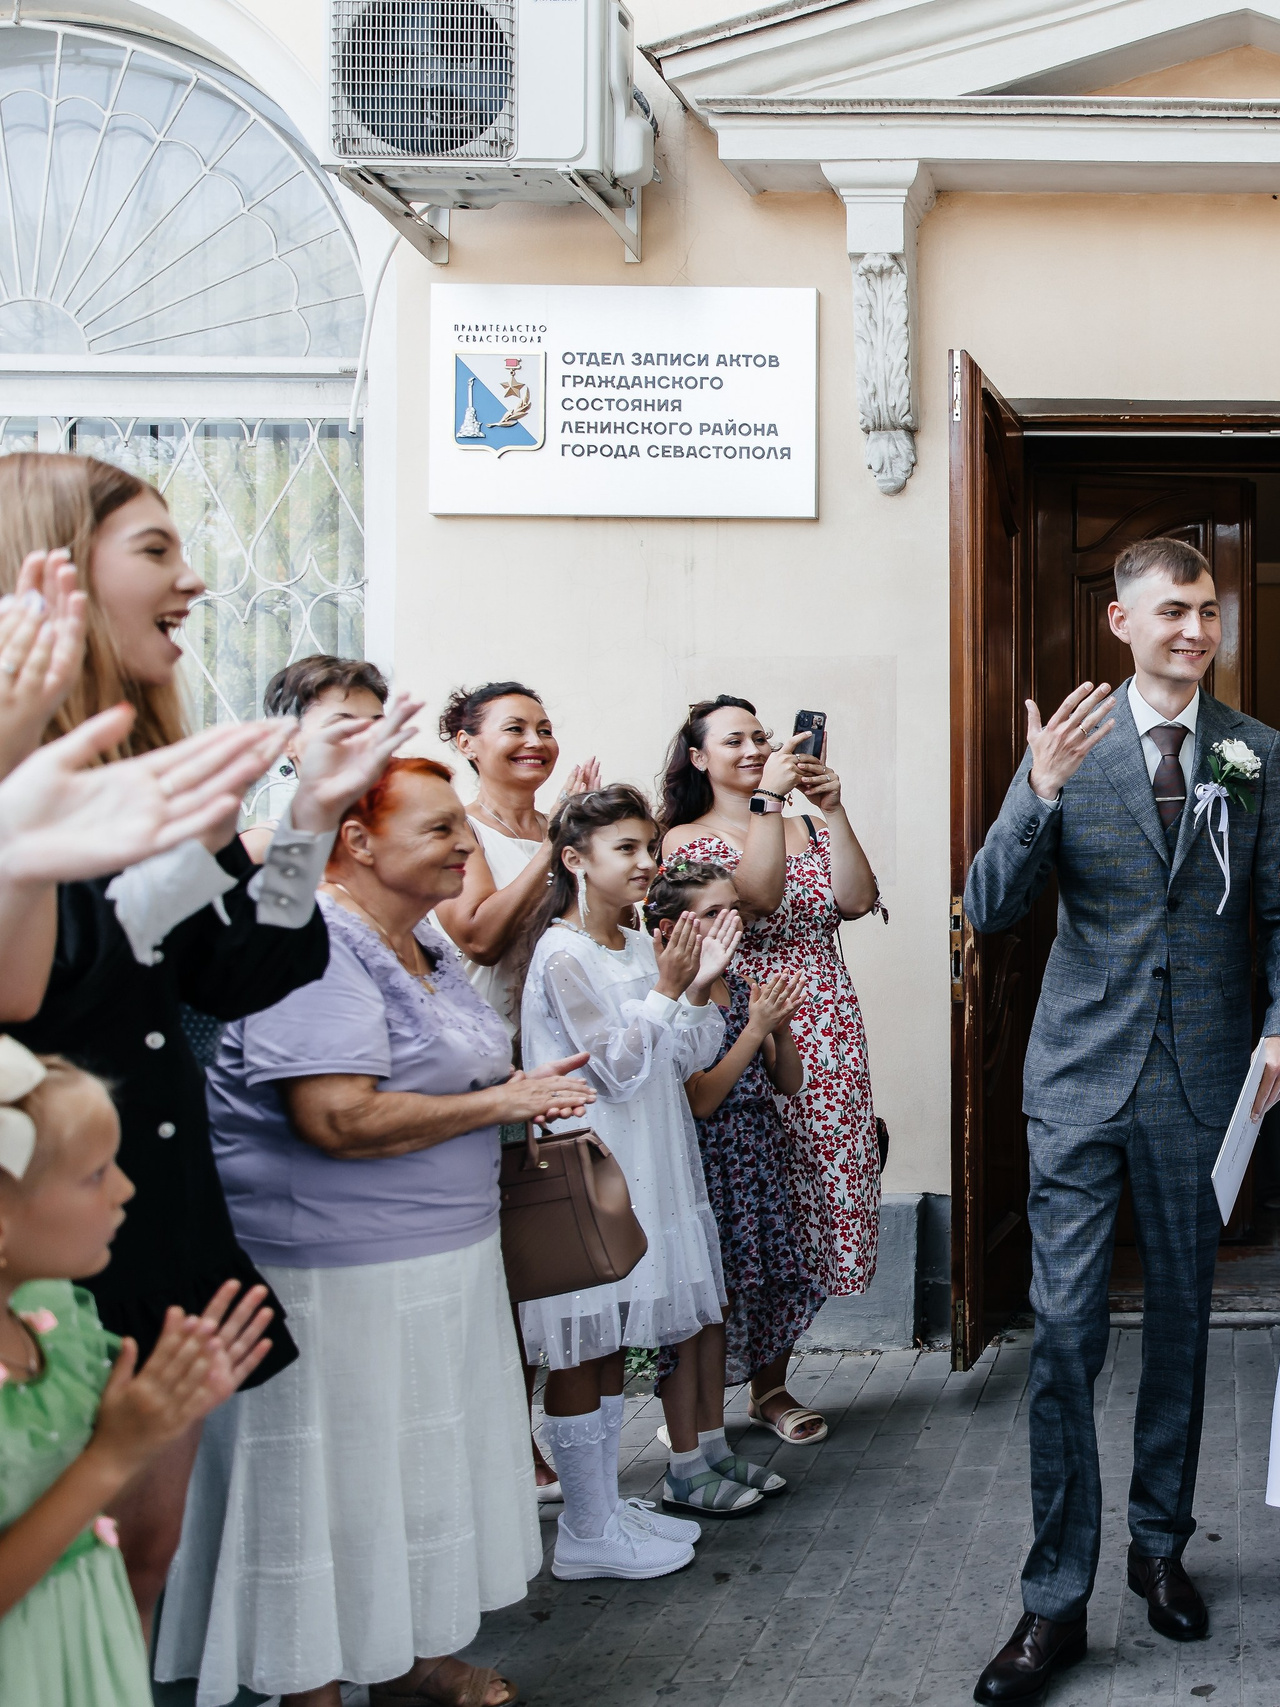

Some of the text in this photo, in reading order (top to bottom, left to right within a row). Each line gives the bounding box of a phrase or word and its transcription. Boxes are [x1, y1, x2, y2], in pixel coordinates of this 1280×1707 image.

[453, 324, 548, 333] ПРАВИТЕЛЬСТВО
[457, 334, 542, 344] СЕВАСТОПОЛЯ
[561, 351, 780, 369] ОТДЕЛ ЗАПИСИ АКТОВ
[561, 374, 724, 391] ГРАЖДАНСКОГО
[560, 397, 682, 412] СОСТОЯНИЯ
[560, 418, 779, 437] ЛЕНИНСКОГО РАЙОНА
[561, 443, 792, 460] ГОРОДА СЕВАСТОПОЛЯ
